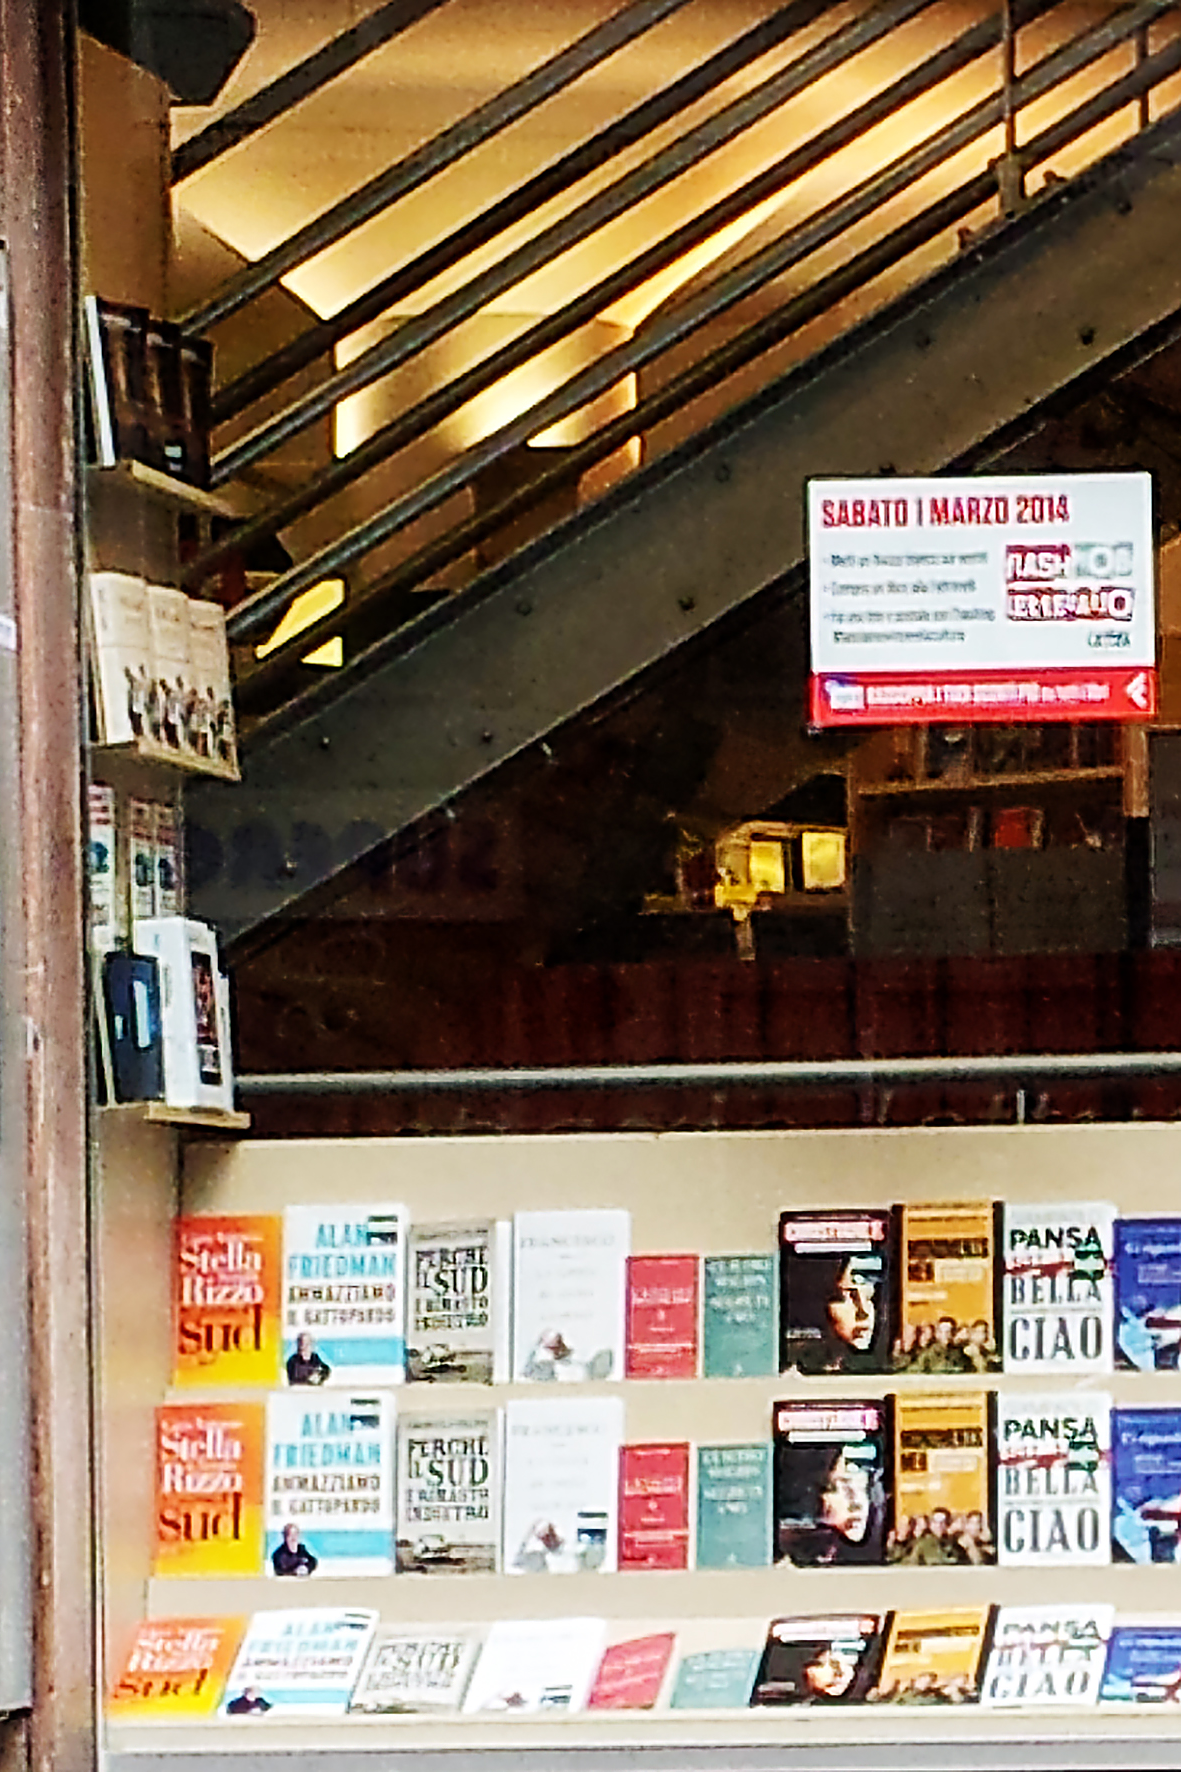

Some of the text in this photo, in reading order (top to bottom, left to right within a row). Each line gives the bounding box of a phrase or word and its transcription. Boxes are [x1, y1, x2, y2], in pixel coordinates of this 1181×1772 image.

[822, 499, 908, 528] SABATO
[930, 496, 1009, 526] MARZO
[1016, 494, 1071, 524] 2014
[1010, 1226, 1102, 1250] PANSA
[180, 1240, 262, 1273] Stella
[289, 1252, 396, 1279] FRIEDMAN
[181, 1274, 264, 1306] Rizzo
[433, 1265, 488, 1296] SUD
[1010, 1276, 1102, 1305] BELLA
[179, 1303, 261, 1354] Sud
[1010, 1316, 1102, 1360] CIAO
[161, 1427, 242, 1461] Stella
[1004, 1417, 1098, 1441] PANSA
[274, 1442, 381, 1467] FRIEDMAN
[162, 1462, 242, 1492] Rizzo
[426, 1458, 489, 1487] SUD
[1005, 1467, 1099, 1496] BELLA
[159, 1491, 243, 1541] Sud
[1004, 1508, 1100, 1553] CIAO
[1003, 1620, 1098, 1638] PANSA
